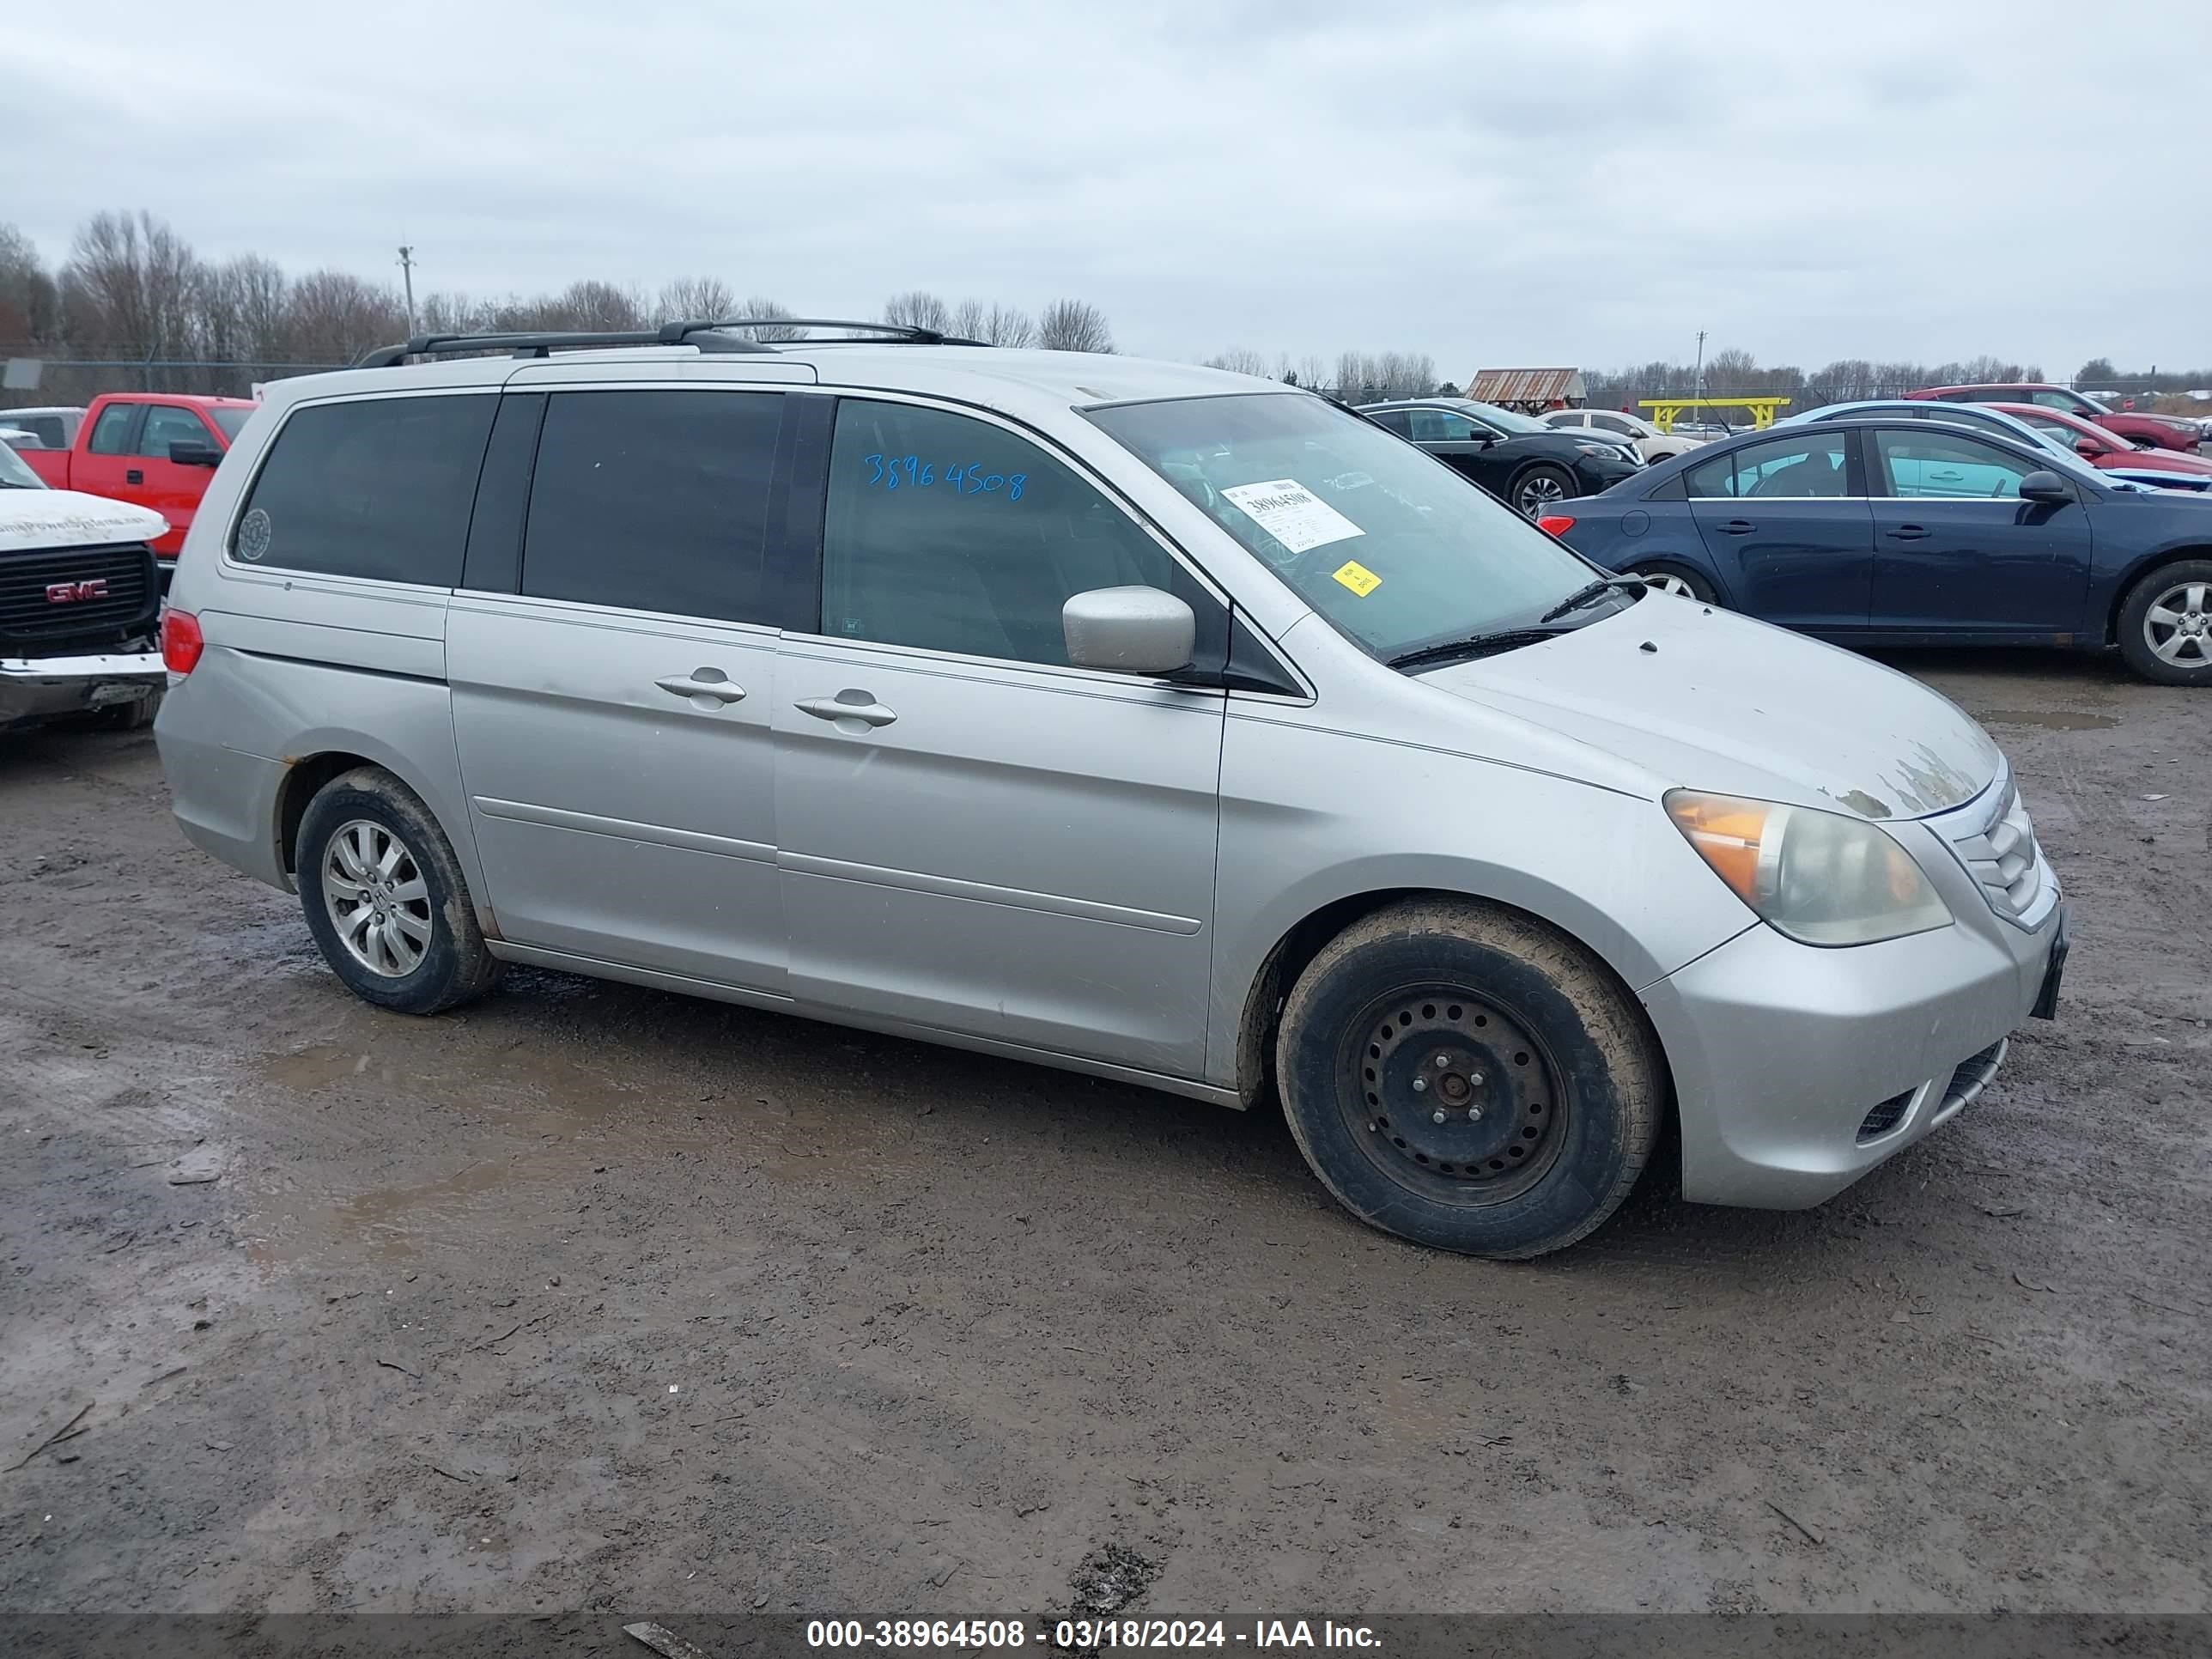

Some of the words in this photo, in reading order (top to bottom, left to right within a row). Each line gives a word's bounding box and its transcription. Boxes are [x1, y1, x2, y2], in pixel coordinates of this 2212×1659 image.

[865, 453, 1028, 501] 38964508
[1247, 492, 1312, 514] 38964508
[46, 579, 109, 603] GMC
